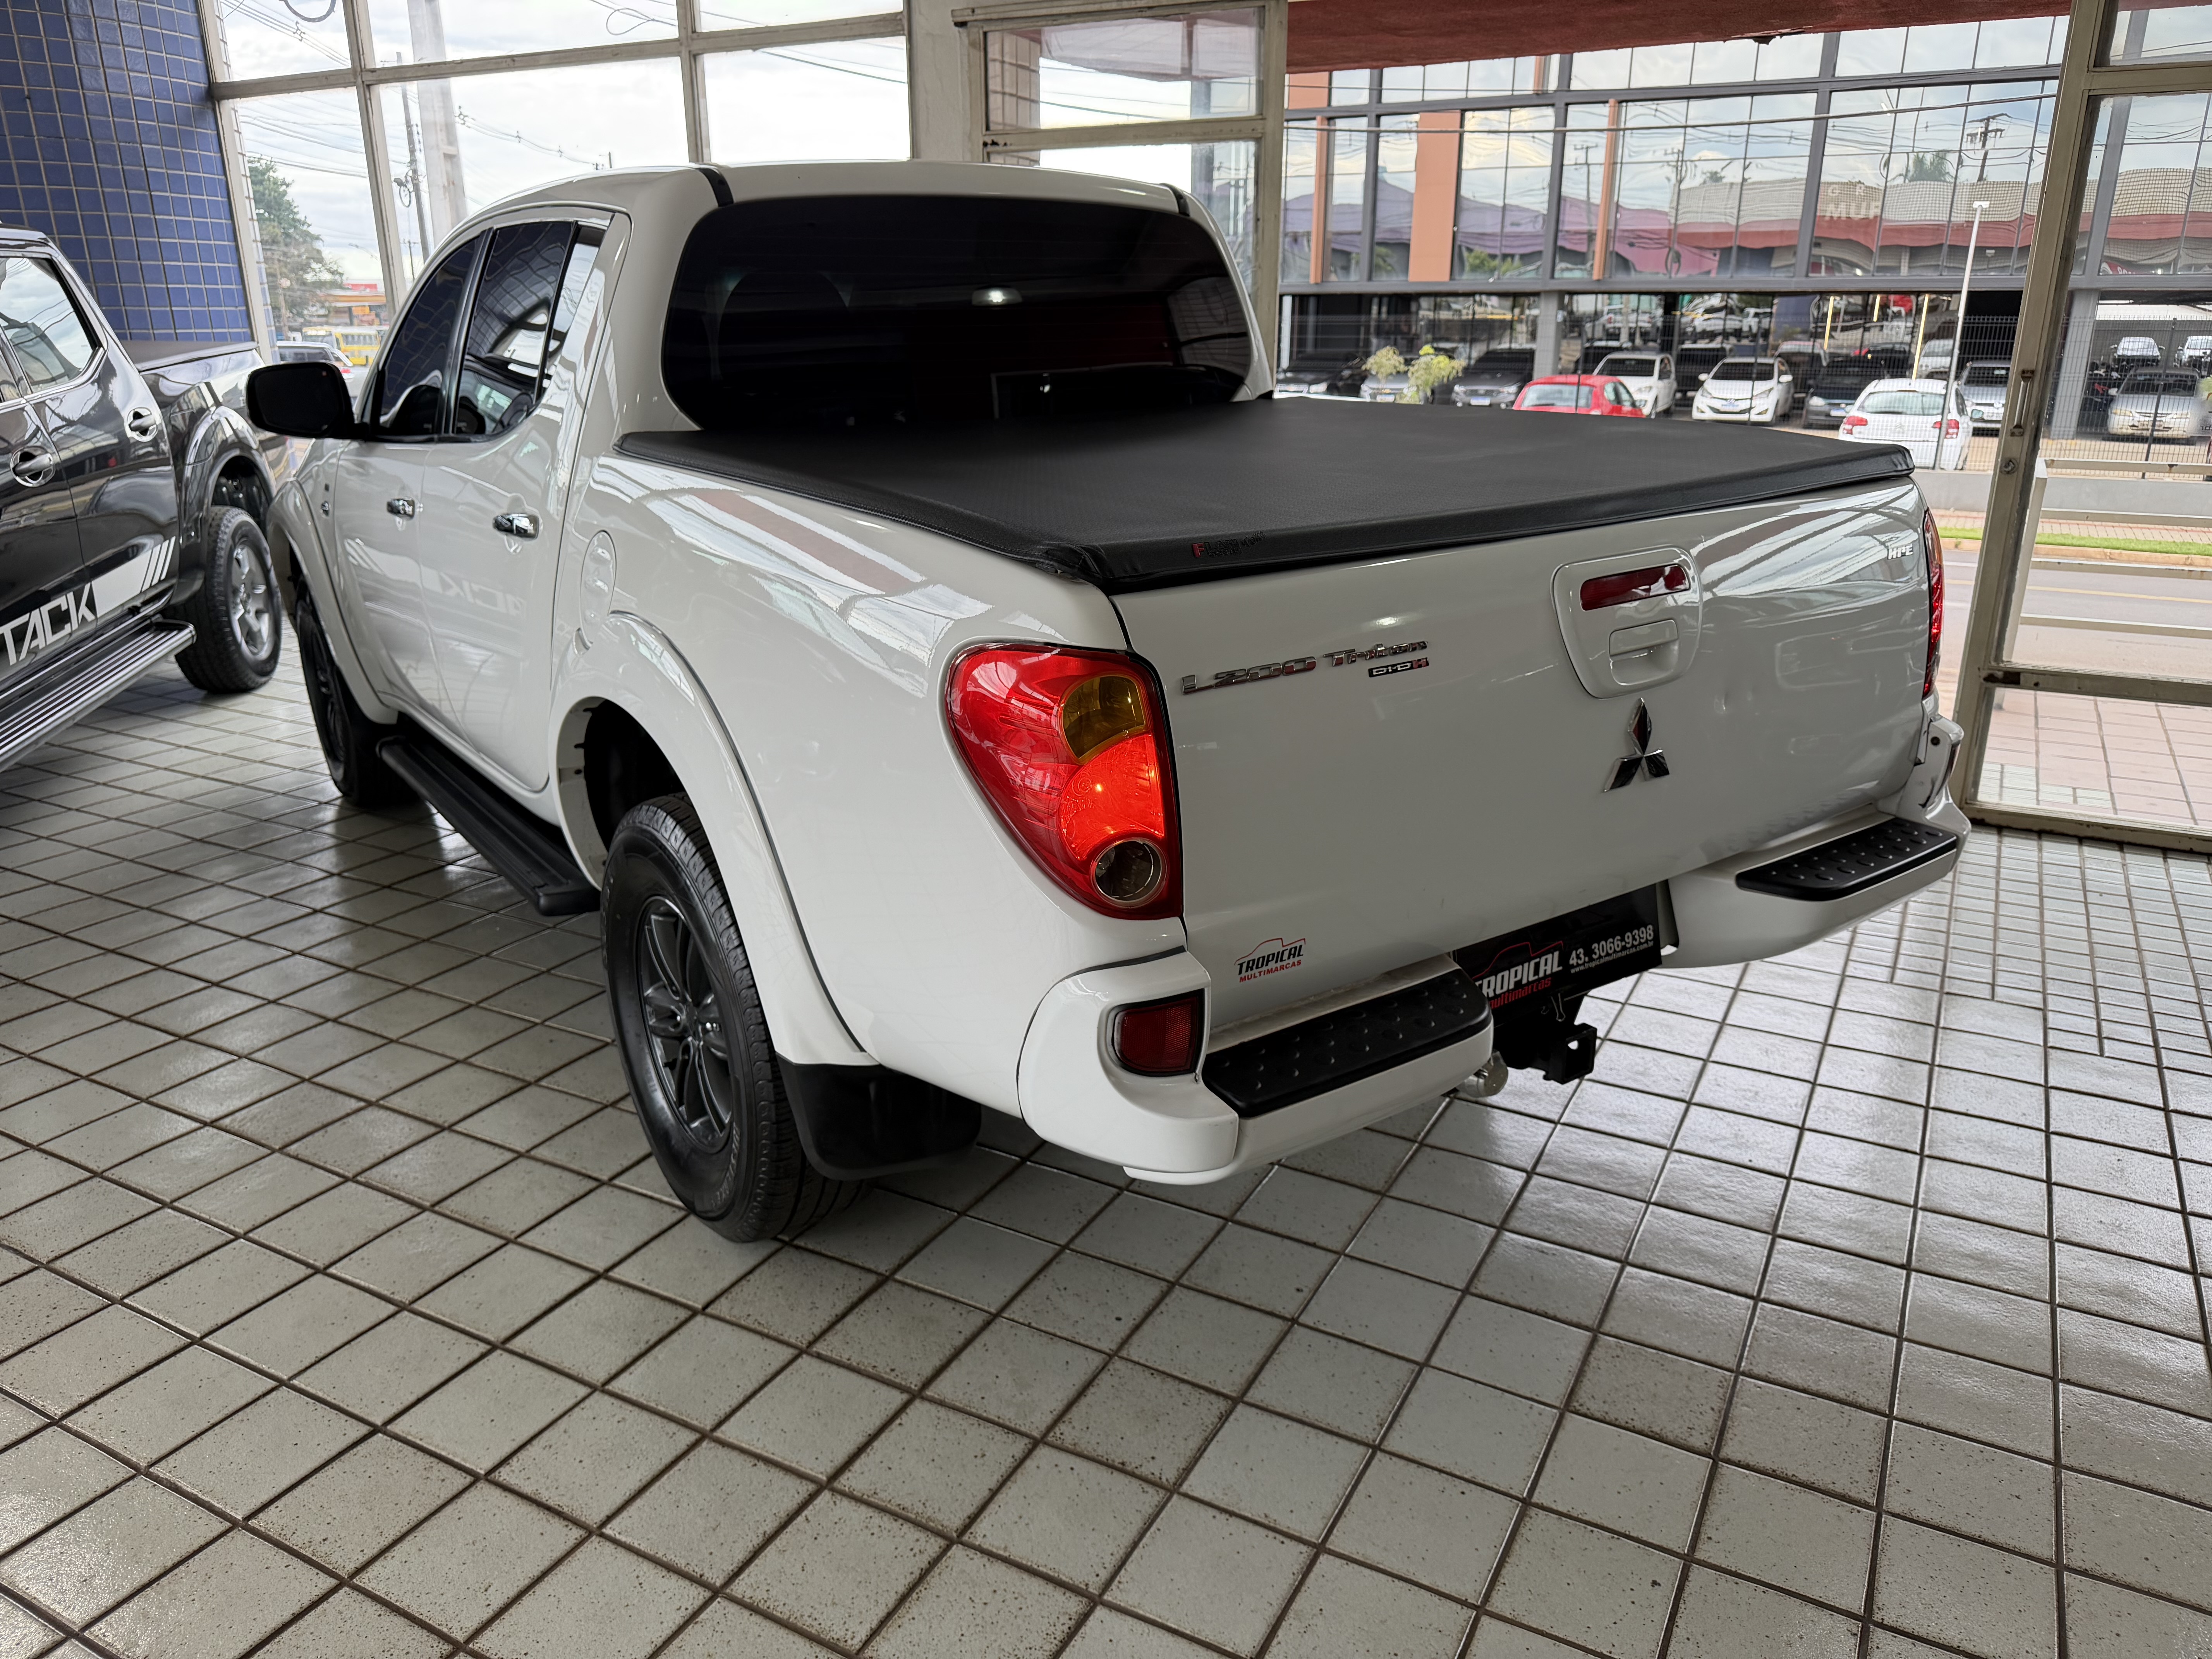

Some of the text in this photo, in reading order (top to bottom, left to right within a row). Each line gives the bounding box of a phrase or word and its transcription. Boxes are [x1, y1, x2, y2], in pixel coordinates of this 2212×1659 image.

[1888, 543, 1913, 560] HPE
[1182, 656, 1316, 696] L200
[1237, 945, 1304, 975] TROPICAL
[1569, 924, 1654, 966] 43. 3066-9398
[1570, 940, 1654, 974] www.tropicalmultimarcas.com.br
[1239, 959, 1302, 983] MULTIMARCAS
